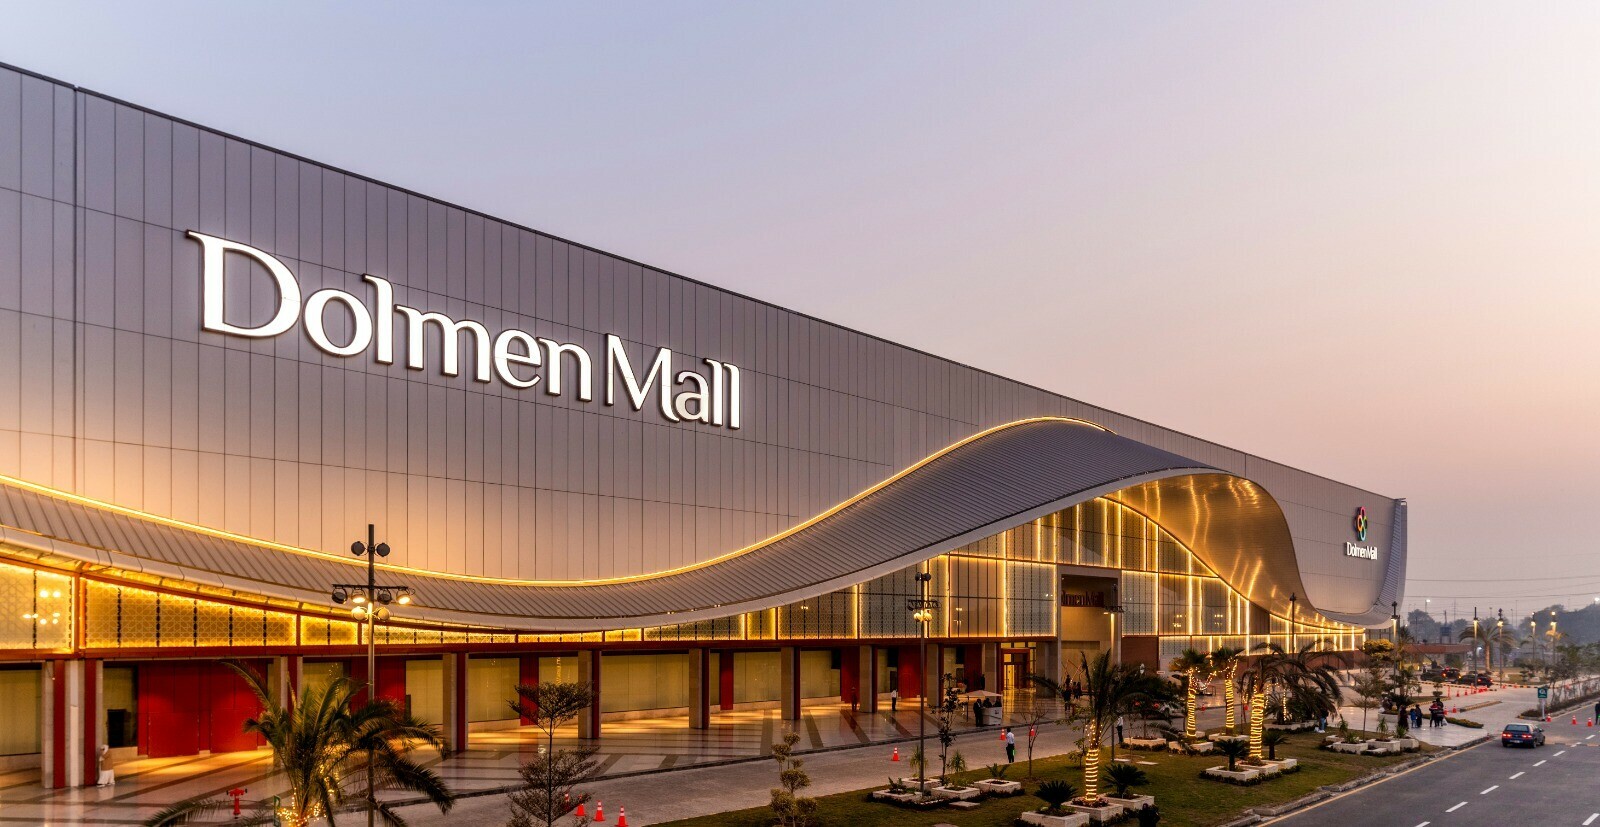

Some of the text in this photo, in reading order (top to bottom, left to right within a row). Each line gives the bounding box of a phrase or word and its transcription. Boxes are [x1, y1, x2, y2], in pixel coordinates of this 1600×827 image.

[186, 230, 740, 430] Dolmen Mall
[1346, 541, 1378, 560] Dolmen Mall
